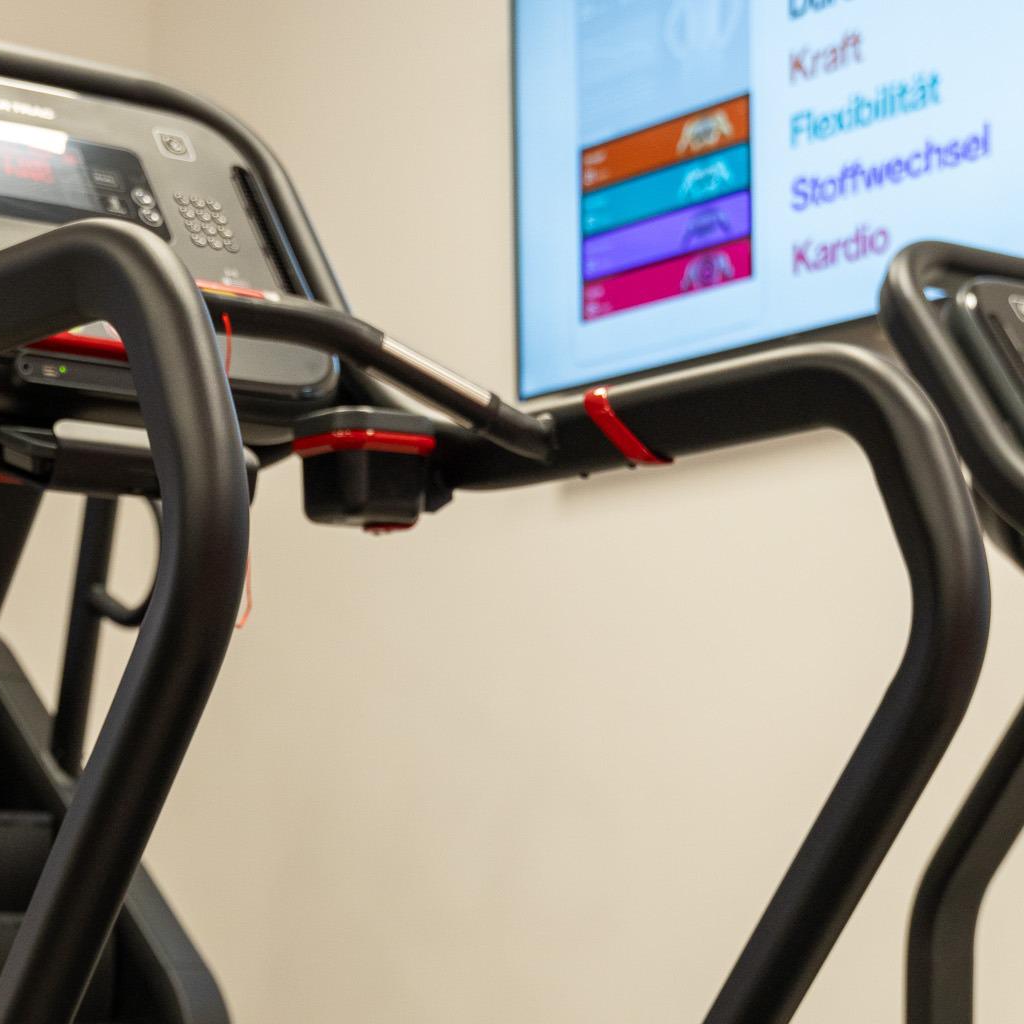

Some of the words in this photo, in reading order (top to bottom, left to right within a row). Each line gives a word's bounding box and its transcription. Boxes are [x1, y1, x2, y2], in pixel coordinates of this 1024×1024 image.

[789, 31, 862, 83] Kraft
[790, 72, 941, 148] Flexibilität
[791, 121, 991, 212] Stoffwechsel
[792, 223, 890, 276] Kardio
